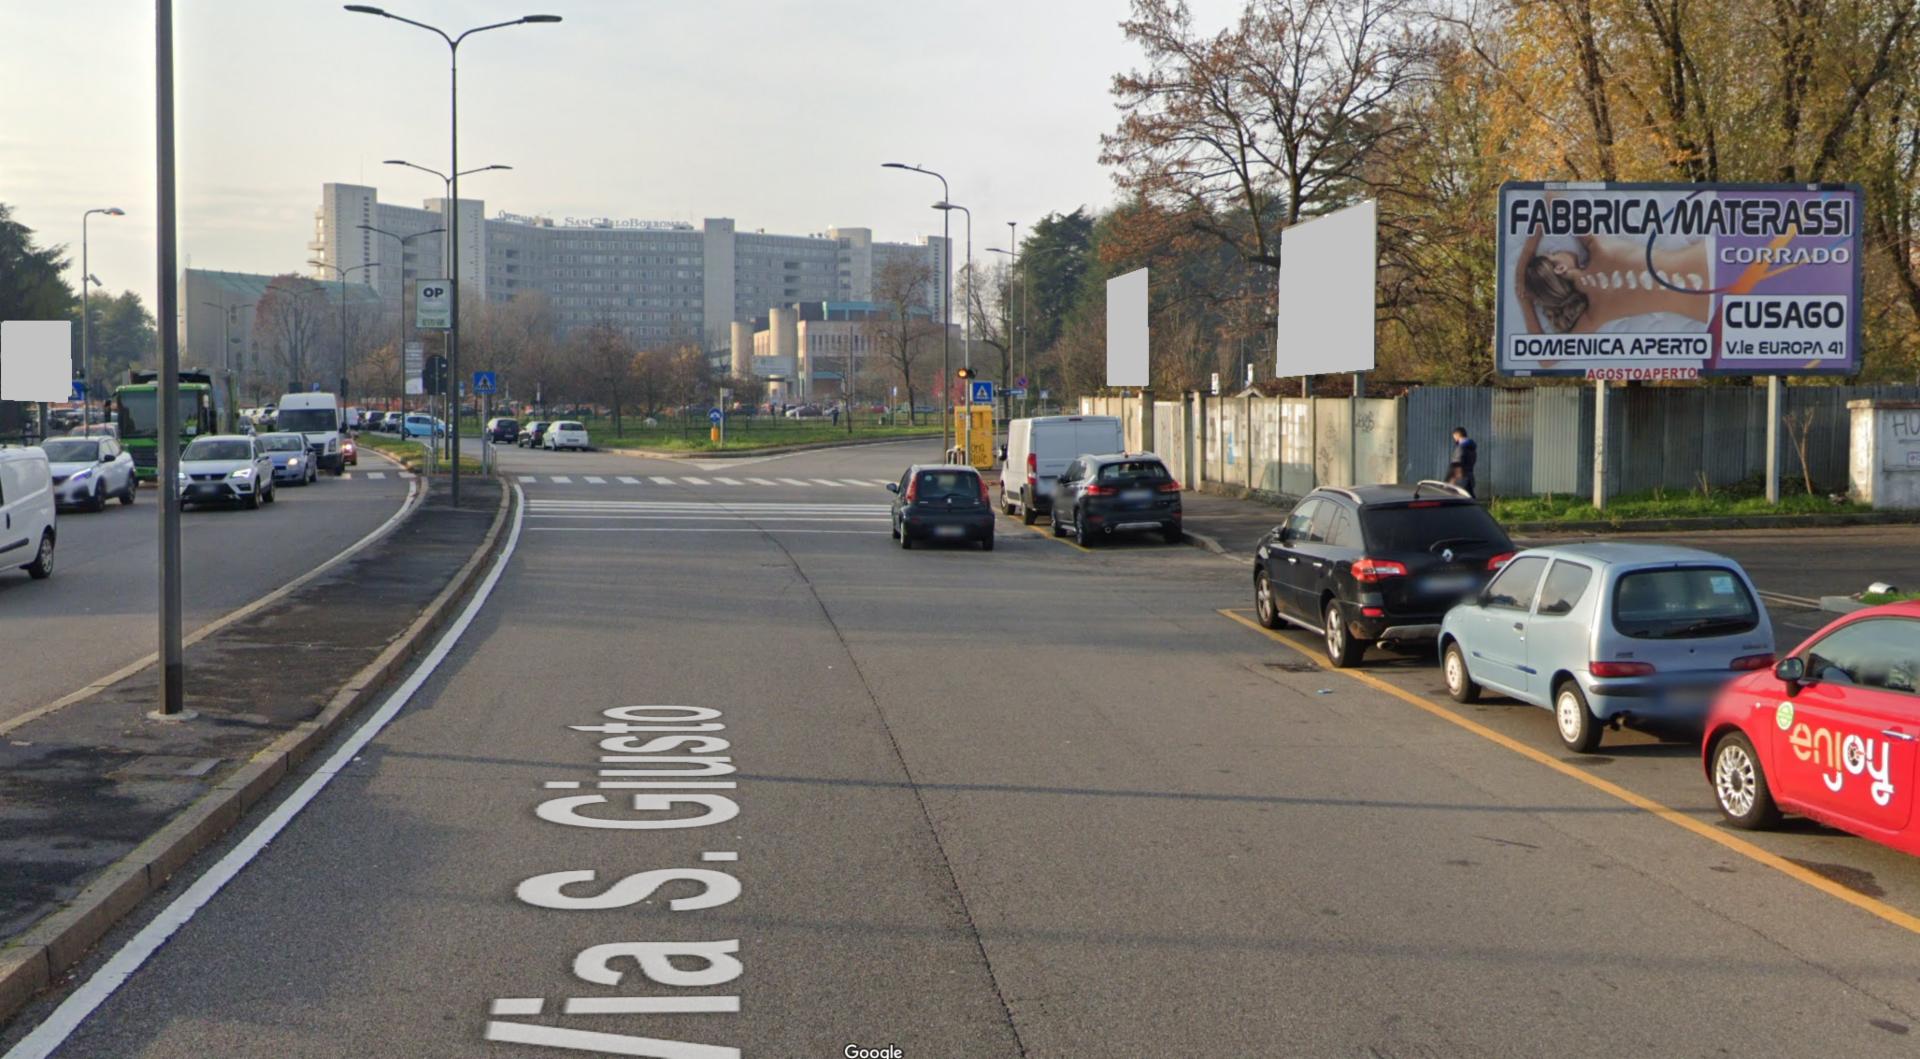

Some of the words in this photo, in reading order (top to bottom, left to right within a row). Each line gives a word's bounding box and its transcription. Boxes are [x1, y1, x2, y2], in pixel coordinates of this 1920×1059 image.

[1510, 198, 1664, 235] FABBRICA
[1669, 198, 1850, 236] MATERASSI
[1720, 247, 1850, 264] CORRADO
[423, 287, 444, 298] OP
[1725, 301, 1845, 329] CUSAGO
[1514, 338, 1625, 357] DOMENICA
[1629, 337, 1708, 355] APERTO
[1758, 341, 1824, 355] EUROPA
[1828, 341, 1843, 355] 41
[1788, 722, 1895, 807] enjoy
